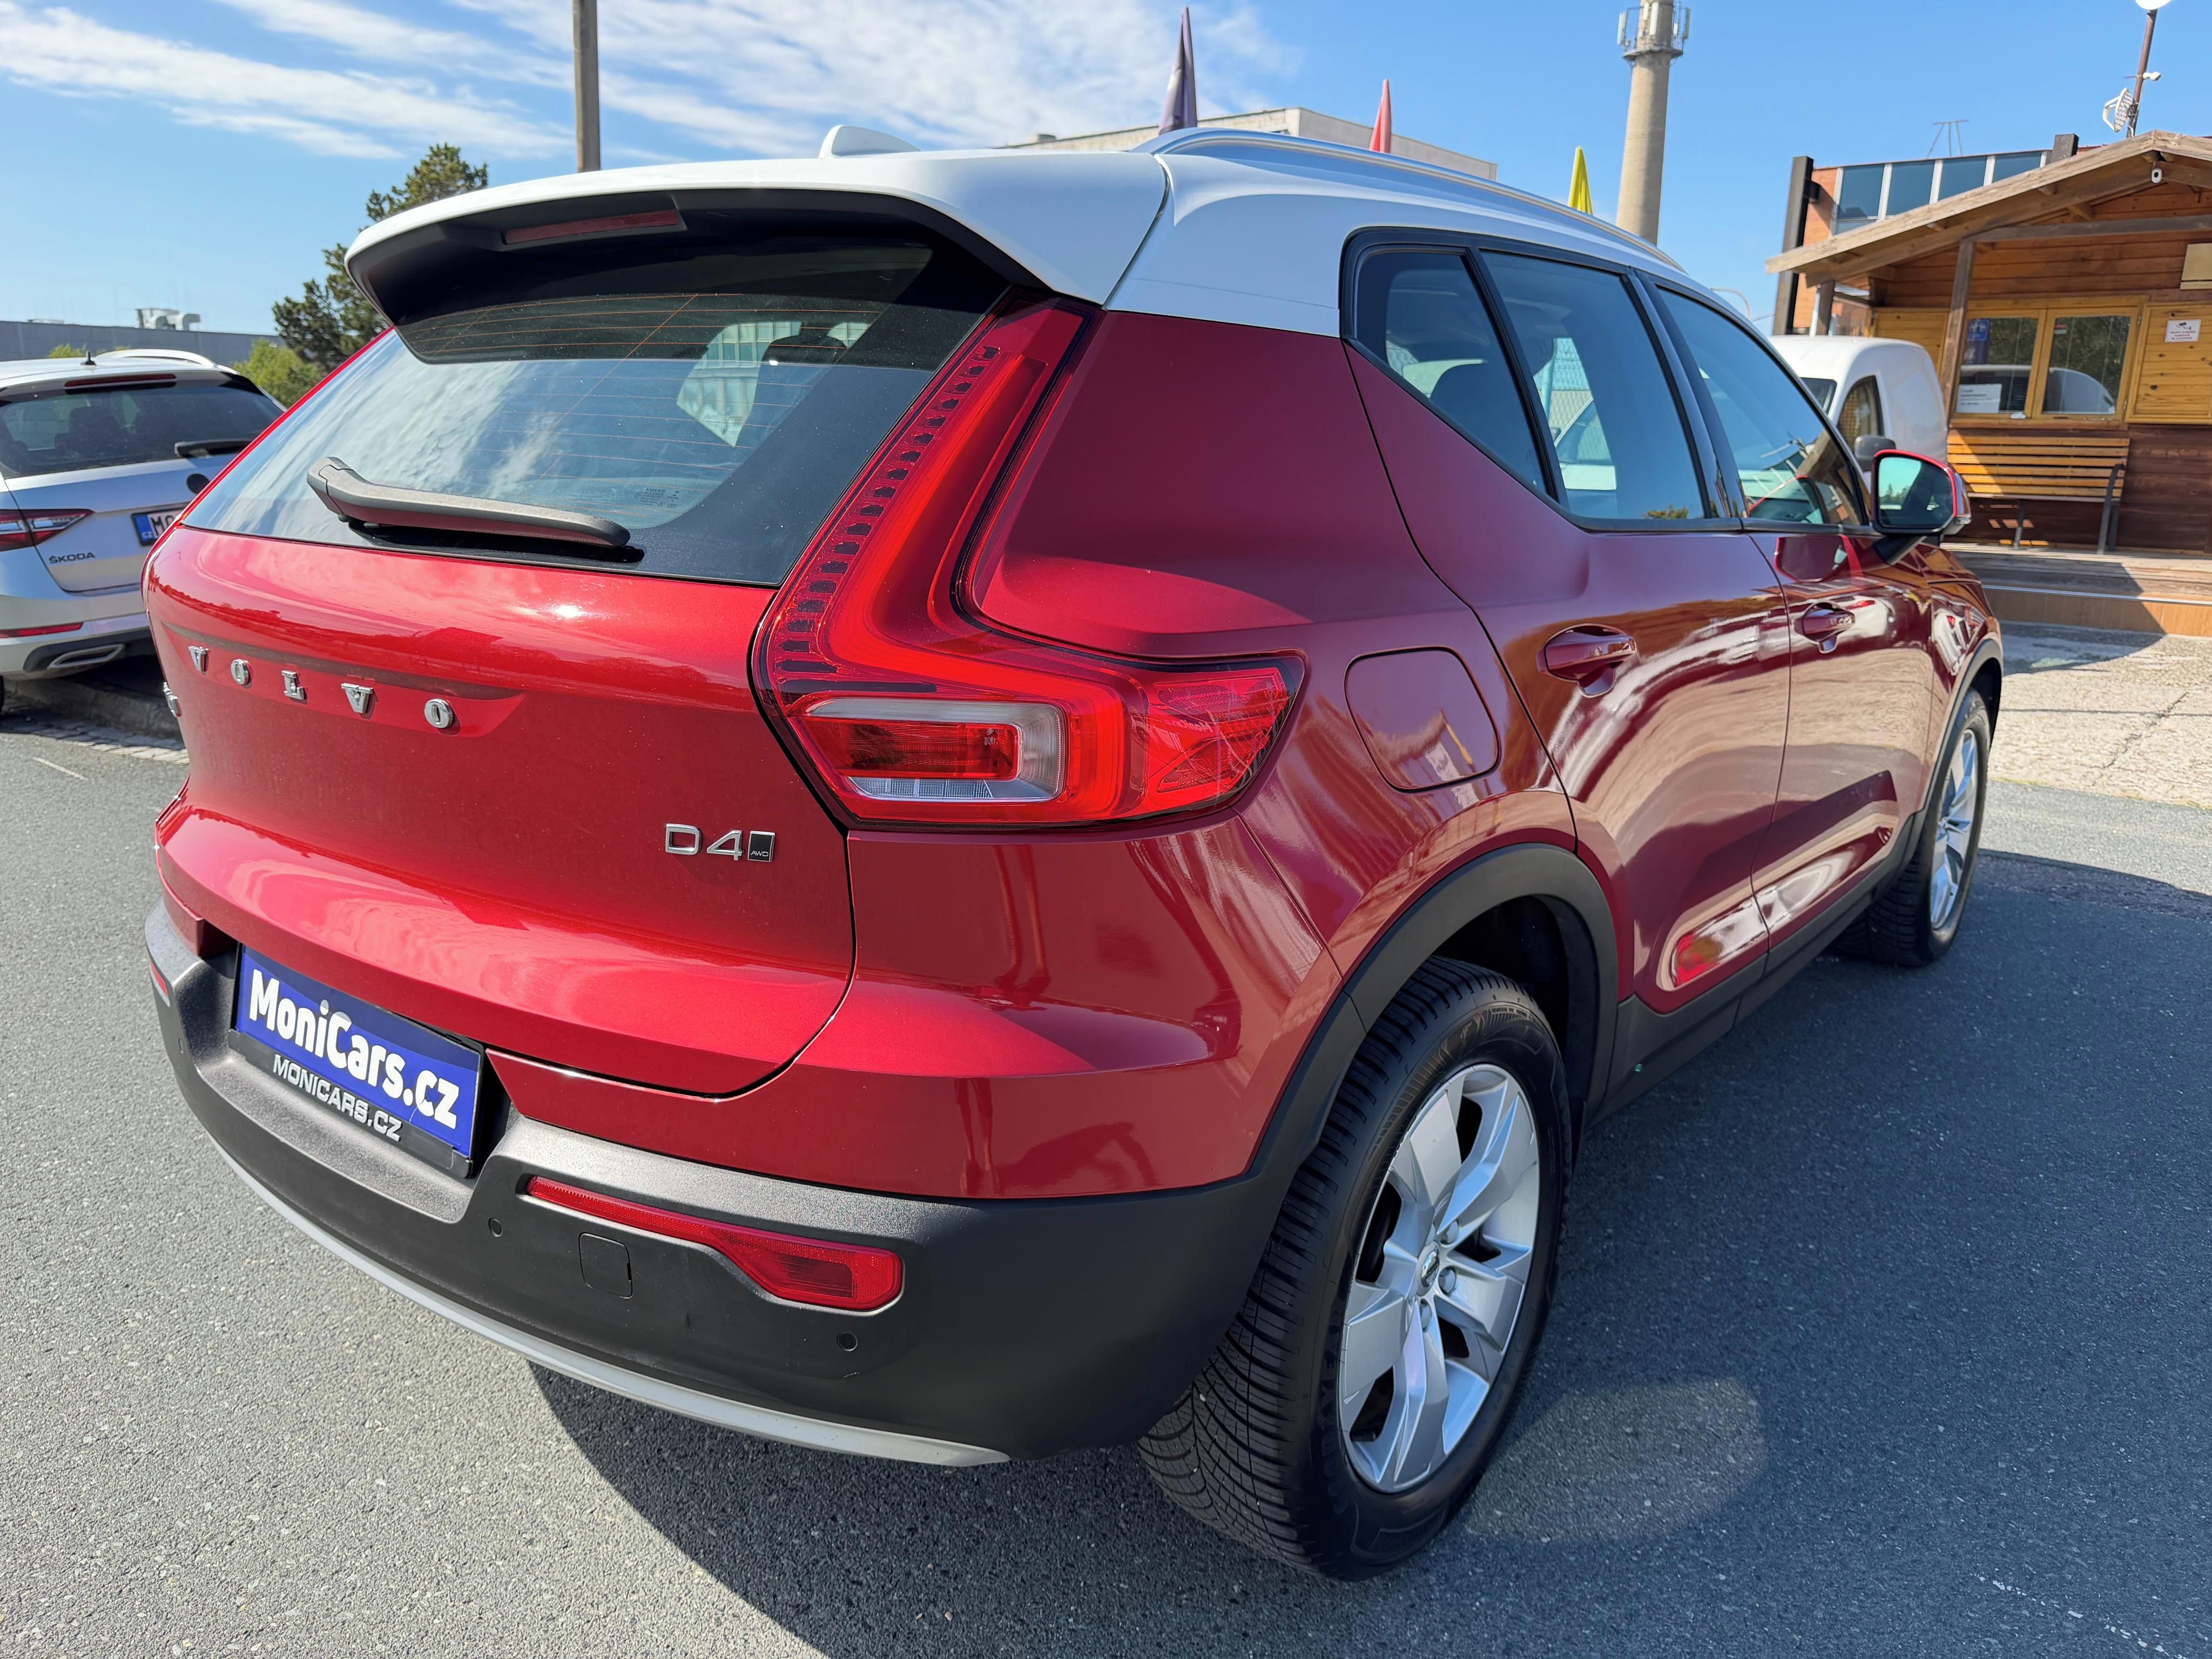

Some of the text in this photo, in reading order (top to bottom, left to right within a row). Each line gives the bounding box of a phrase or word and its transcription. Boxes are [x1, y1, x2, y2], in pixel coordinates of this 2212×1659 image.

[49, 552, 96, 564] ŠKODA
[188, 645, 454, 729] VOLVO
[665, 824, 743, 861] D4
[249, 969, 460, 1129] MoniCars.cz
[273, 1054, 402, 1142] MONICARS.CZ
